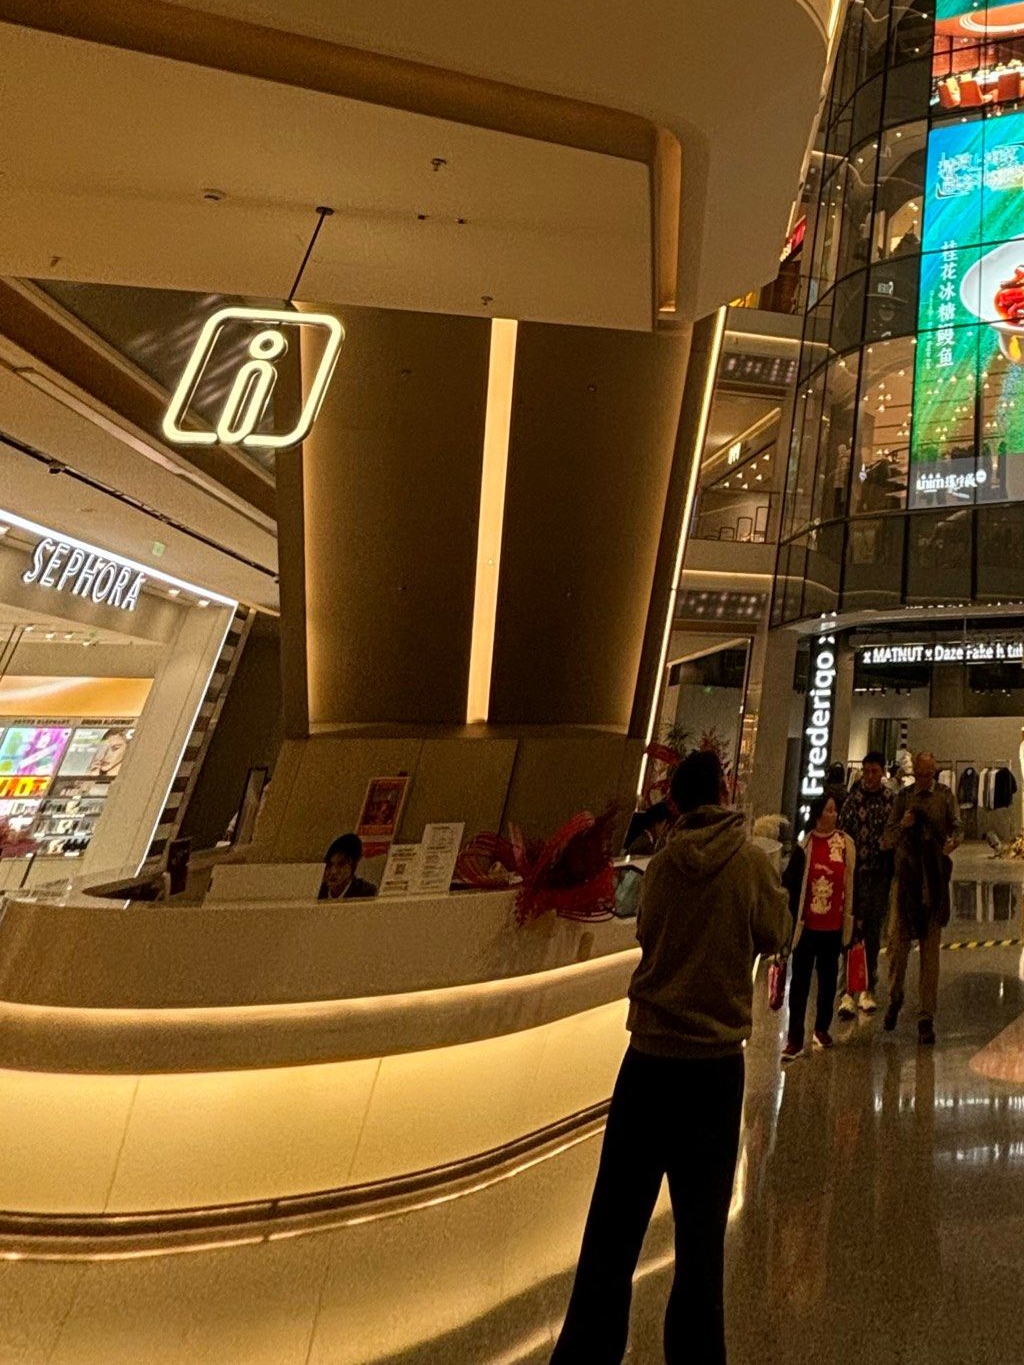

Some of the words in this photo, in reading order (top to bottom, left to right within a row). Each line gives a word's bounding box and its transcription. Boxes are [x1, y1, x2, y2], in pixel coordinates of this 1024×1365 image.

[23, 537, 146, 612] SEPHORA
[934, 645, 963, 661] Daze
[802, 651, 836, 796] Frederiqo
